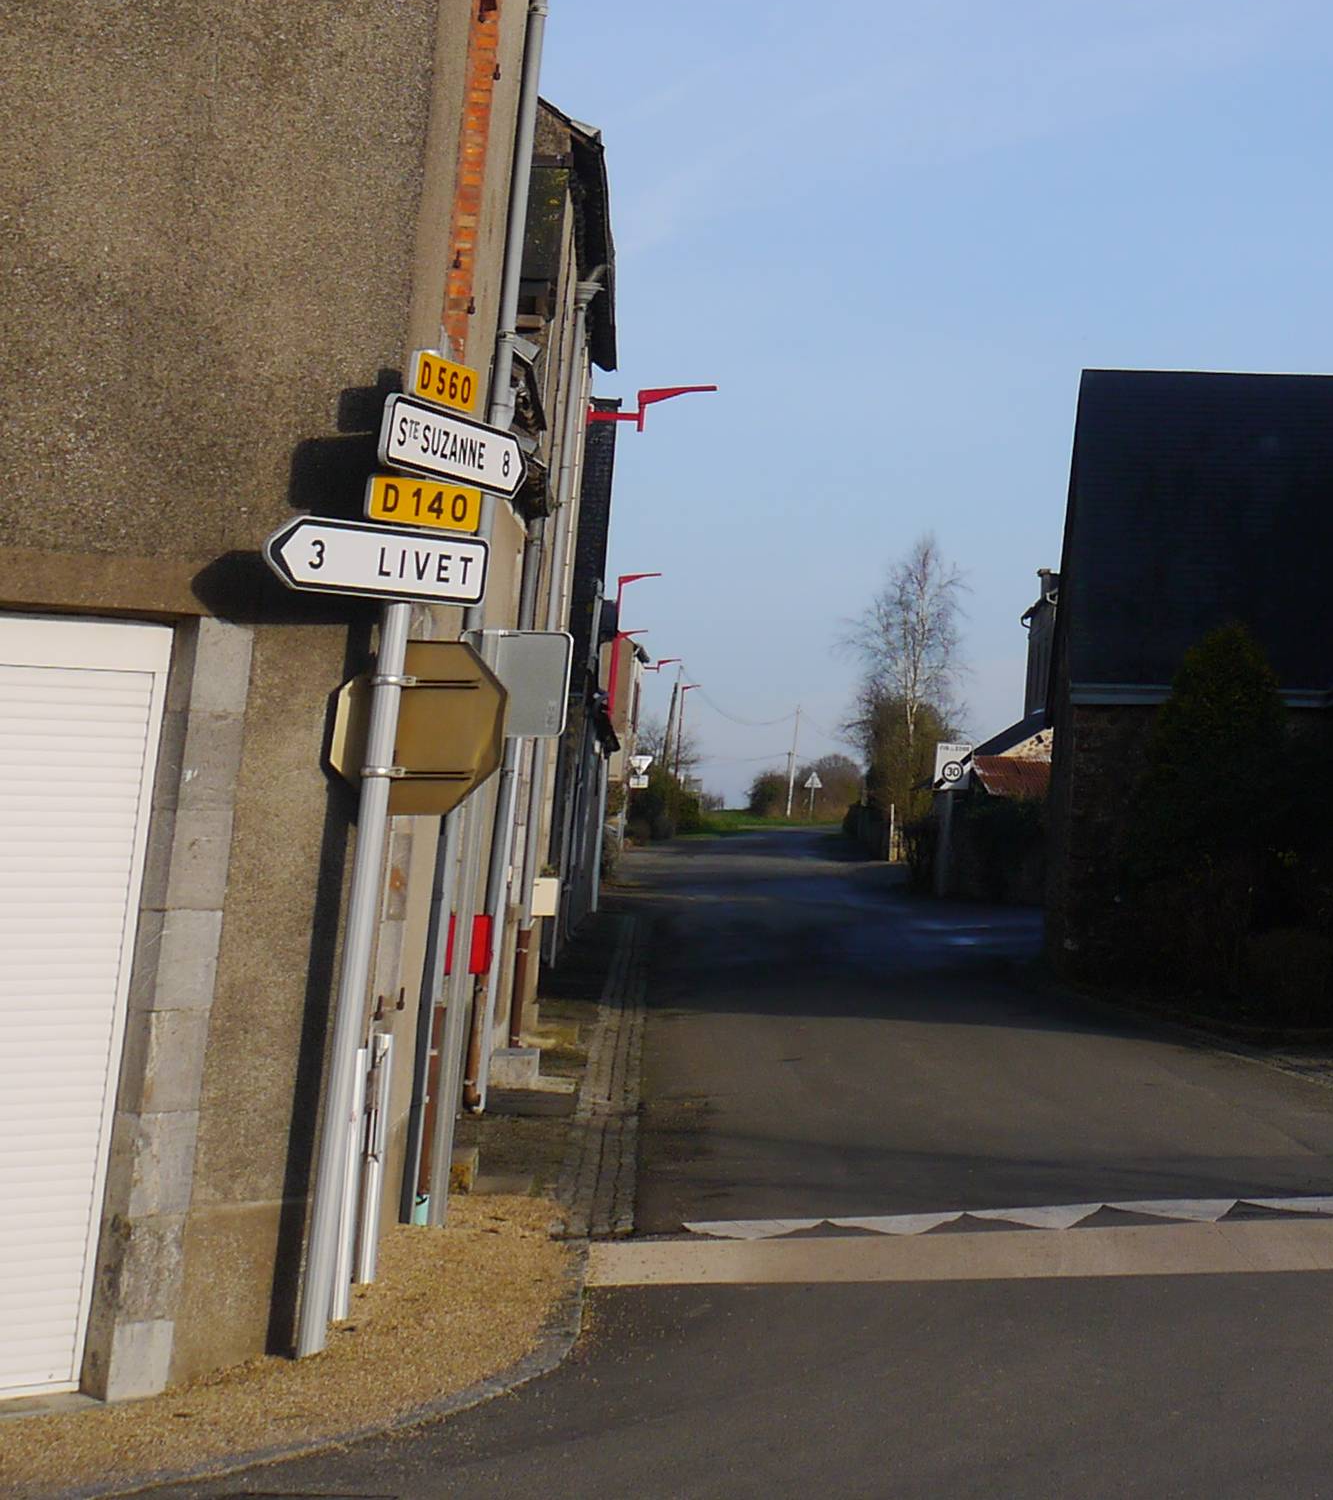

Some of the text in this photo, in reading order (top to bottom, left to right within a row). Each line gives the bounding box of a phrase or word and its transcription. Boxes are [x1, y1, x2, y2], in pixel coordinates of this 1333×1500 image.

[436, 367, 471, 404] 560
[421, 425, 486, 471] SUZANNE
[502, 450, 510, 477] 8
[382, 484, 468, 523] D 140
[308, 539, 473, 585] 3 LIVET
[946, 767, 960, 777] 30
